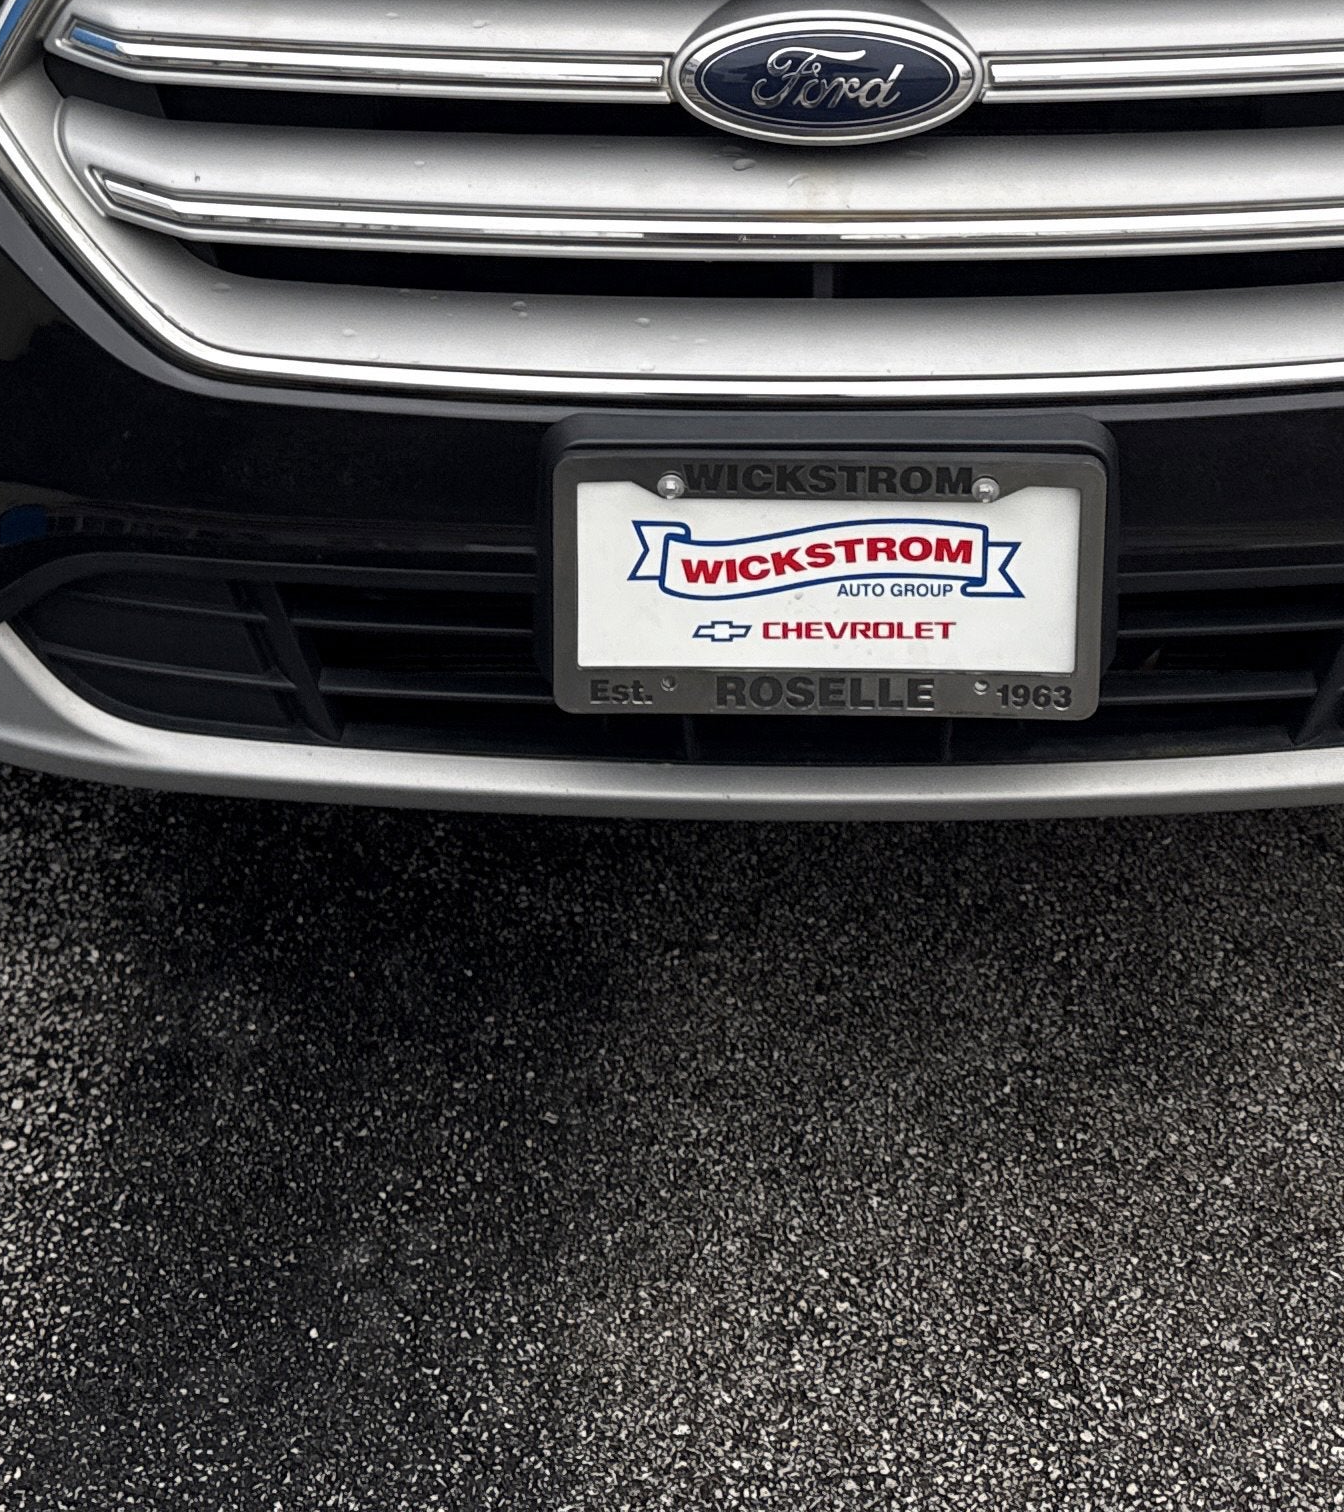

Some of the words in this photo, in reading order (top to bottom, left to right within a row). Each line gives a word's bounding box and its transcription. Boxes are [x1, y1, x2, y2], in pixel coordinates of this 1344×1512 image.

[751, 46, 904, 109] Ford
[683, 464, 973, 496] WICKSTROM
[681, 536, 973, 584] WICKSTROM
[837, 583, 886, 598] AUTO
[890, 583, 954, 598] GROUP
[762, 621, 956, 640] CHEVROLET
[590, 679, 654, 704] Est.
[716, 676, 936, 710] ROSELLE
[996, 683, 1073, 709] 1963
